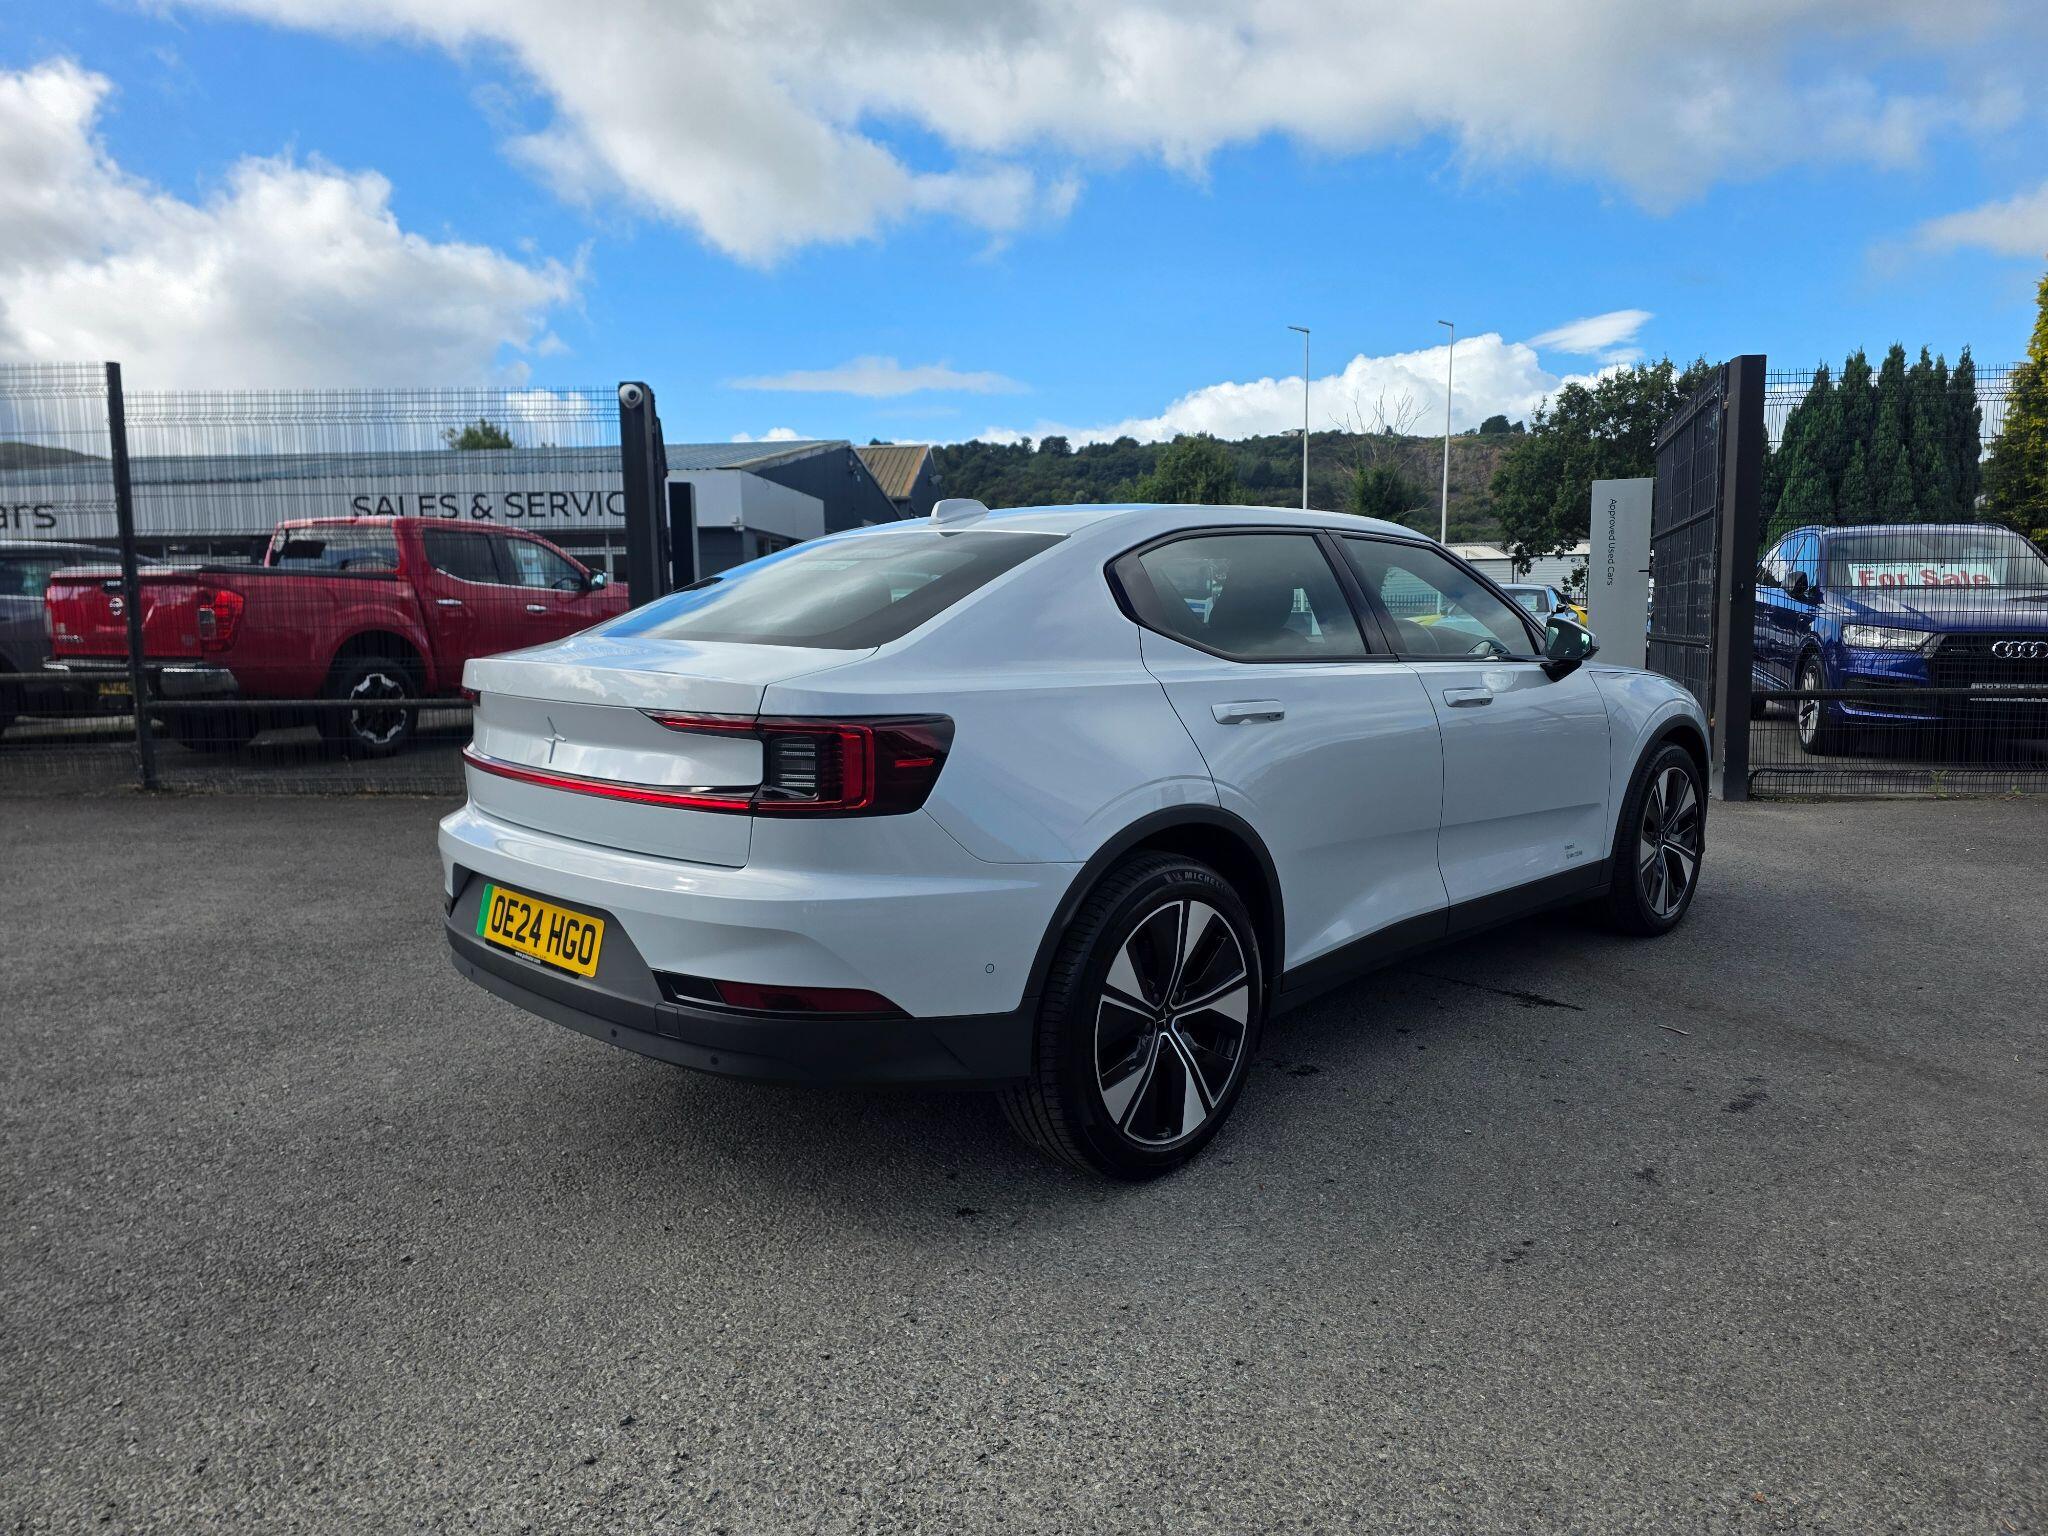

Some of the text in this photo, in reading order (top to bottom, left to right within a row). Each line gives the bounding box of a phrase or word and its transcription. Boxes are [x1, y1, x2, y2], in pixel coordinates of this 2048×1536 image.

[353, 491, 626, 519] SALES & SERVIC
[1606, 498, 1618, 586] Approved Used Cars
[1858, 569, 1991, 590] For Sale
[491, 894, 597, 966] OE24 HGO
